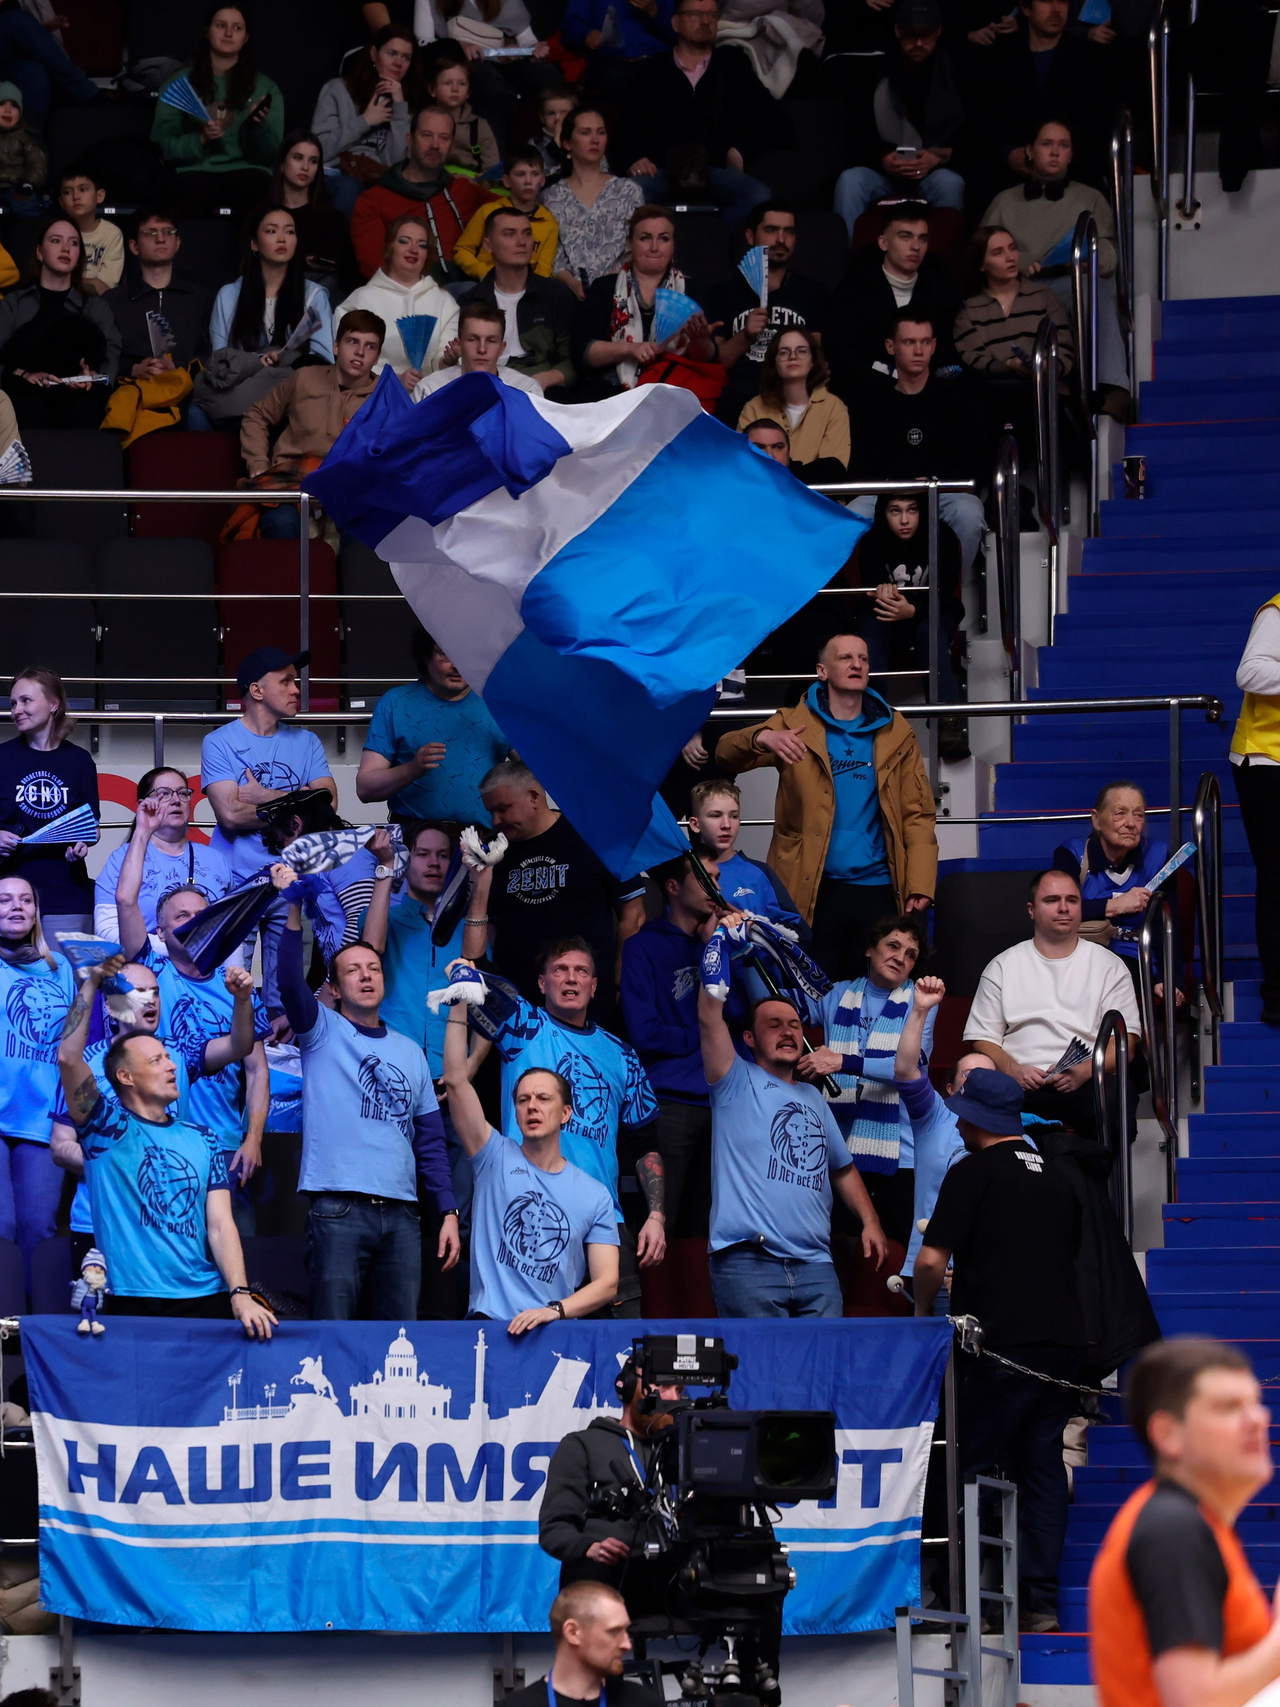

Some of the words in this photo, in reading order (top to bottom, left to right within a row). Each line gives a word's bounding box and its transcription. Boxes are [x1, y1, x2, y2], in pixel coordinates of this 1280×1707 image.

[15, 785, 69, 804] ZENIT
[506, 864, 569, 893] ZENIT
[5, 1029, 16, 1059] 10
[18, 1040, 36, 1061] ЛЕТ
[360, 1093, 371, 1119] 10
[767, 1154, 778, 1180] 10
[778, 1165, 796, 1185] ЛЕТ
[496, 1238, 506, 1264] 10
[506, 1251, 520, 1270] ЛЕТ
[63, 1438, 331, 1505] НАШЕ
[355, 1441, 560, 1503] ИМЯ
